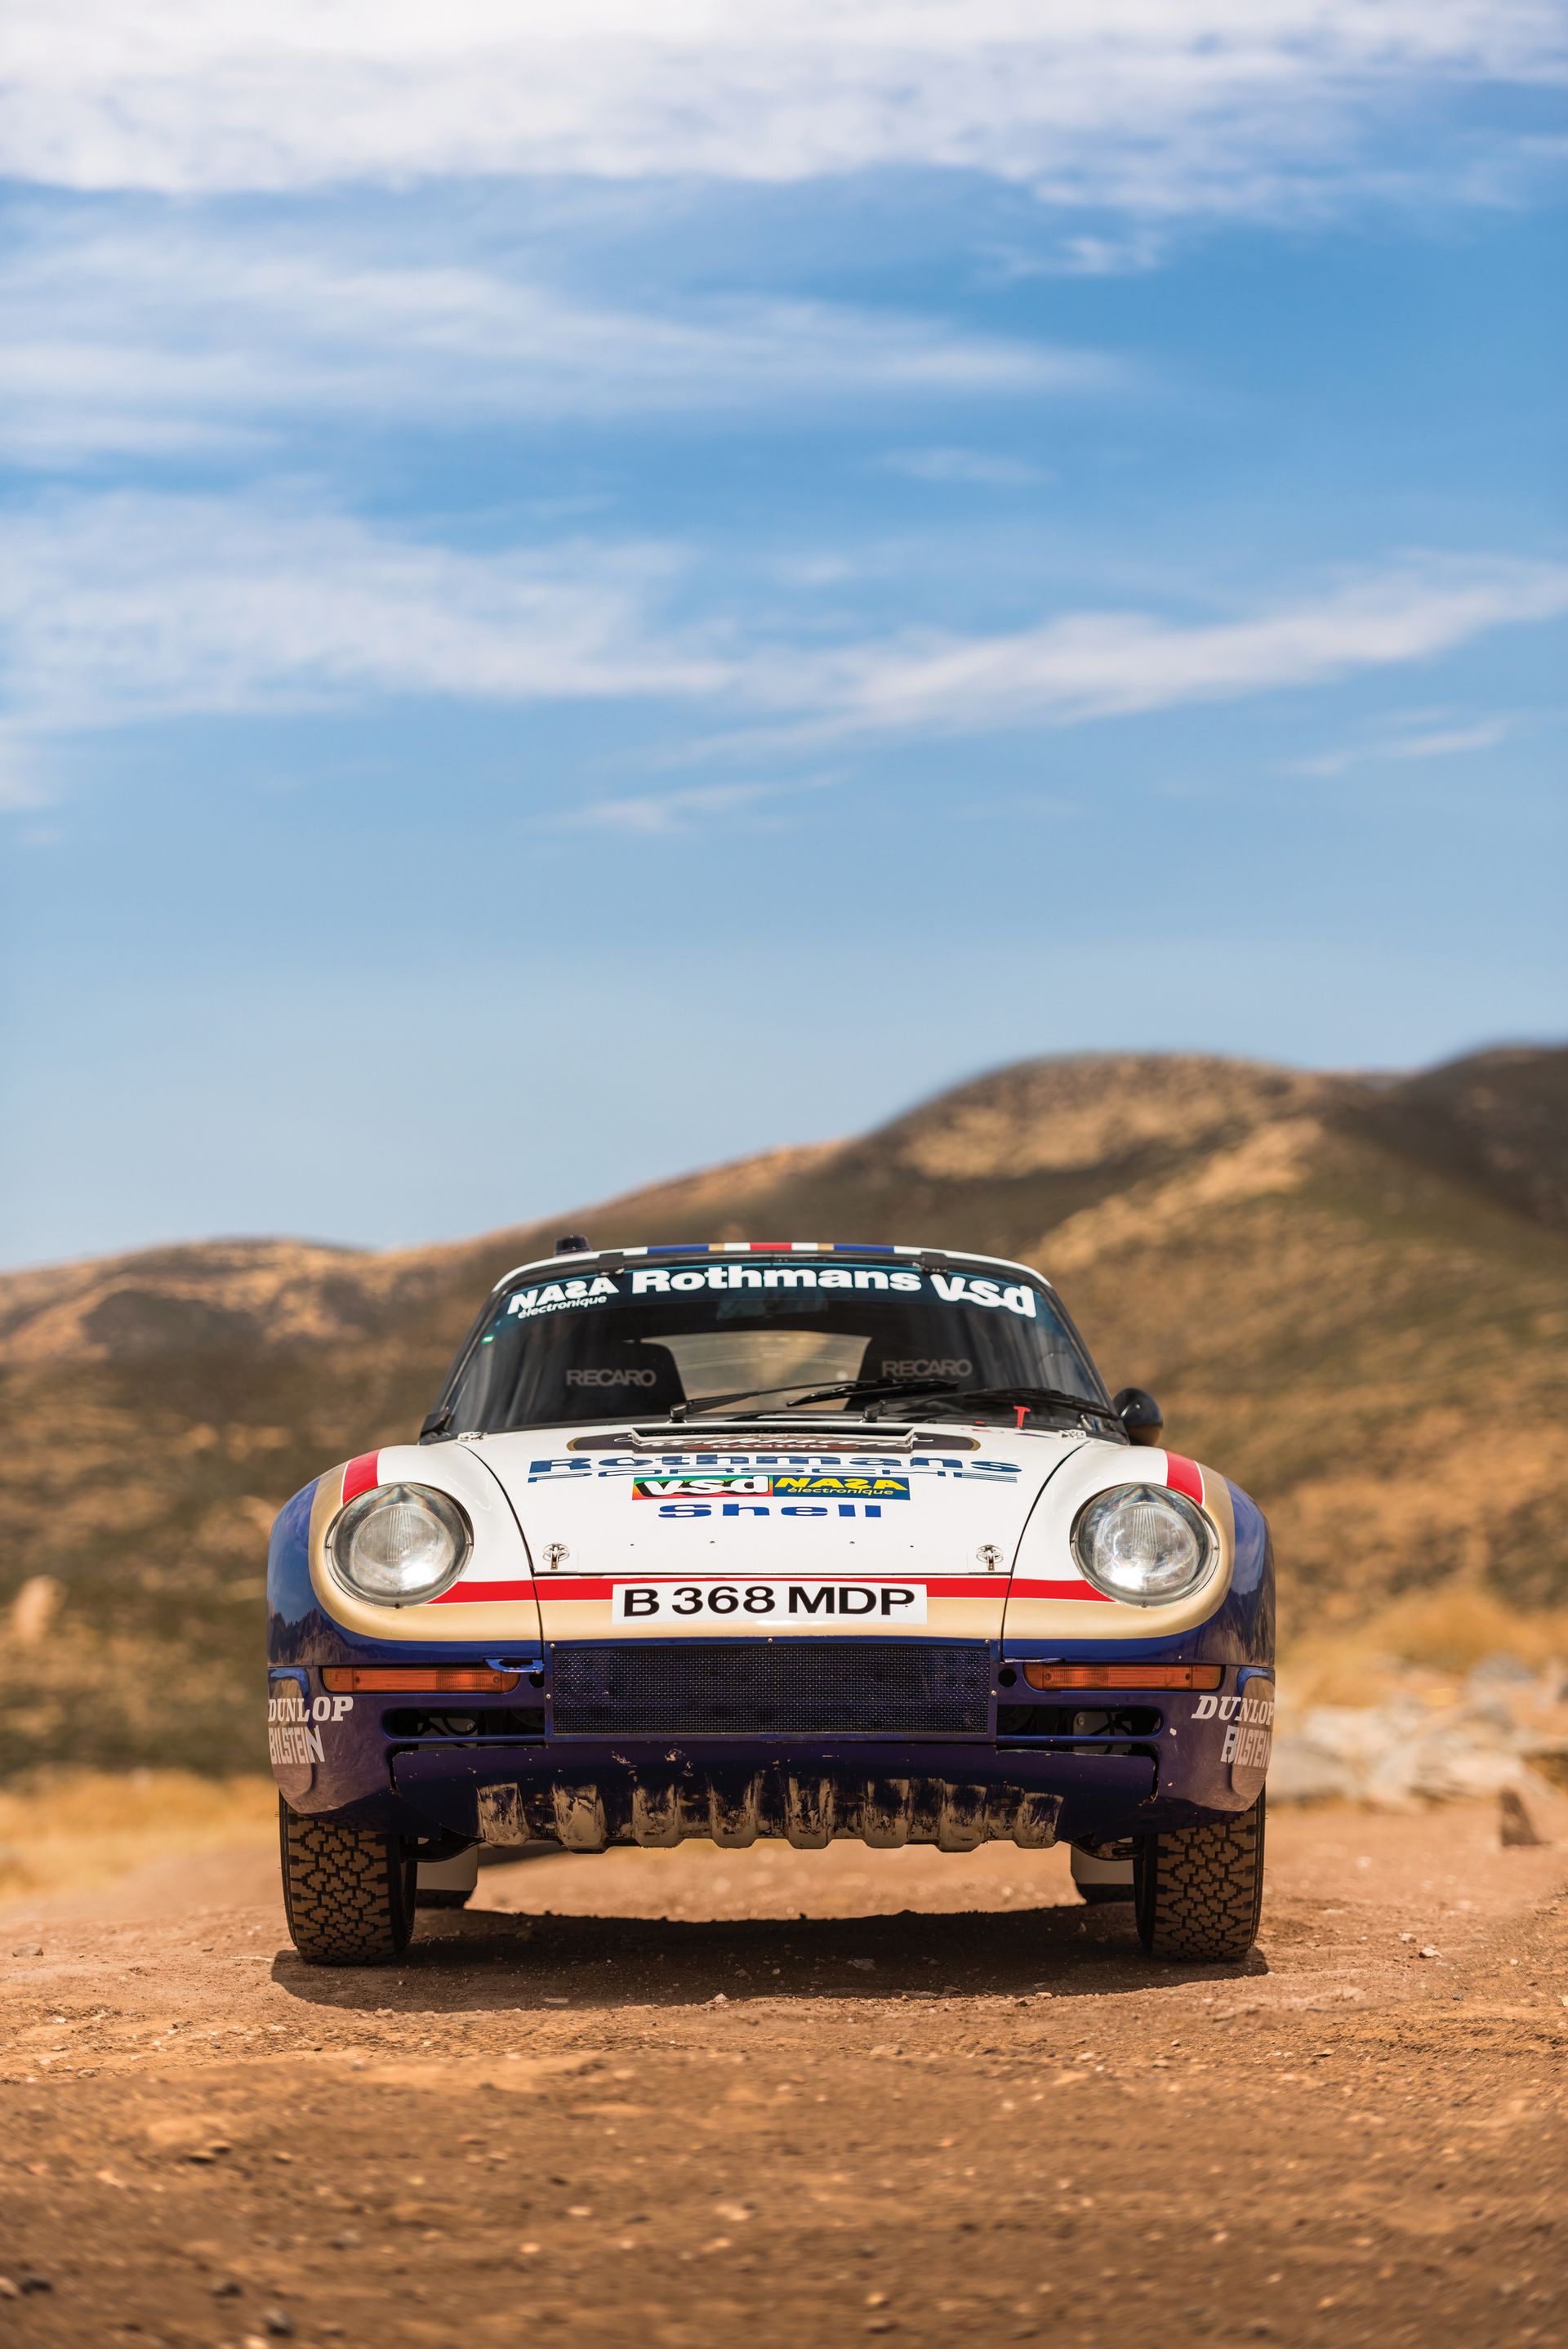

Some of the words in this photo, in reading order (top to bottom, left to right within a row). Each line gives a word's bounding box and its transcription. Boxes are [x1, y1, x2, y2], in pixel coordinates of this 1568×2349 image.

[632, 1266, 922, 1292] Rothmans
[507, 1277, 620, 1315] NASA
[565, 1369, 657, 1387] RECARO
[881, 1359, 973, 1377] RECARO
[529, 1454, 1022, 1473] Rothmans
[775, 1477, 908, 1491] NASA
[787, 1486, 893, 1496] électronique
[658, 1504, 881, 1518] Shell
[624, 1589, 660, 1617] B
[671, 1586, 776, 1616] 368
[788, 1586, 915, 1616] MDP
[268, 1696, 354, 1723] DUNLOP
[1191, 1695, 1274, 1726] DUNLOP
[269, 1724, 325, 1764] BILSTEIN
